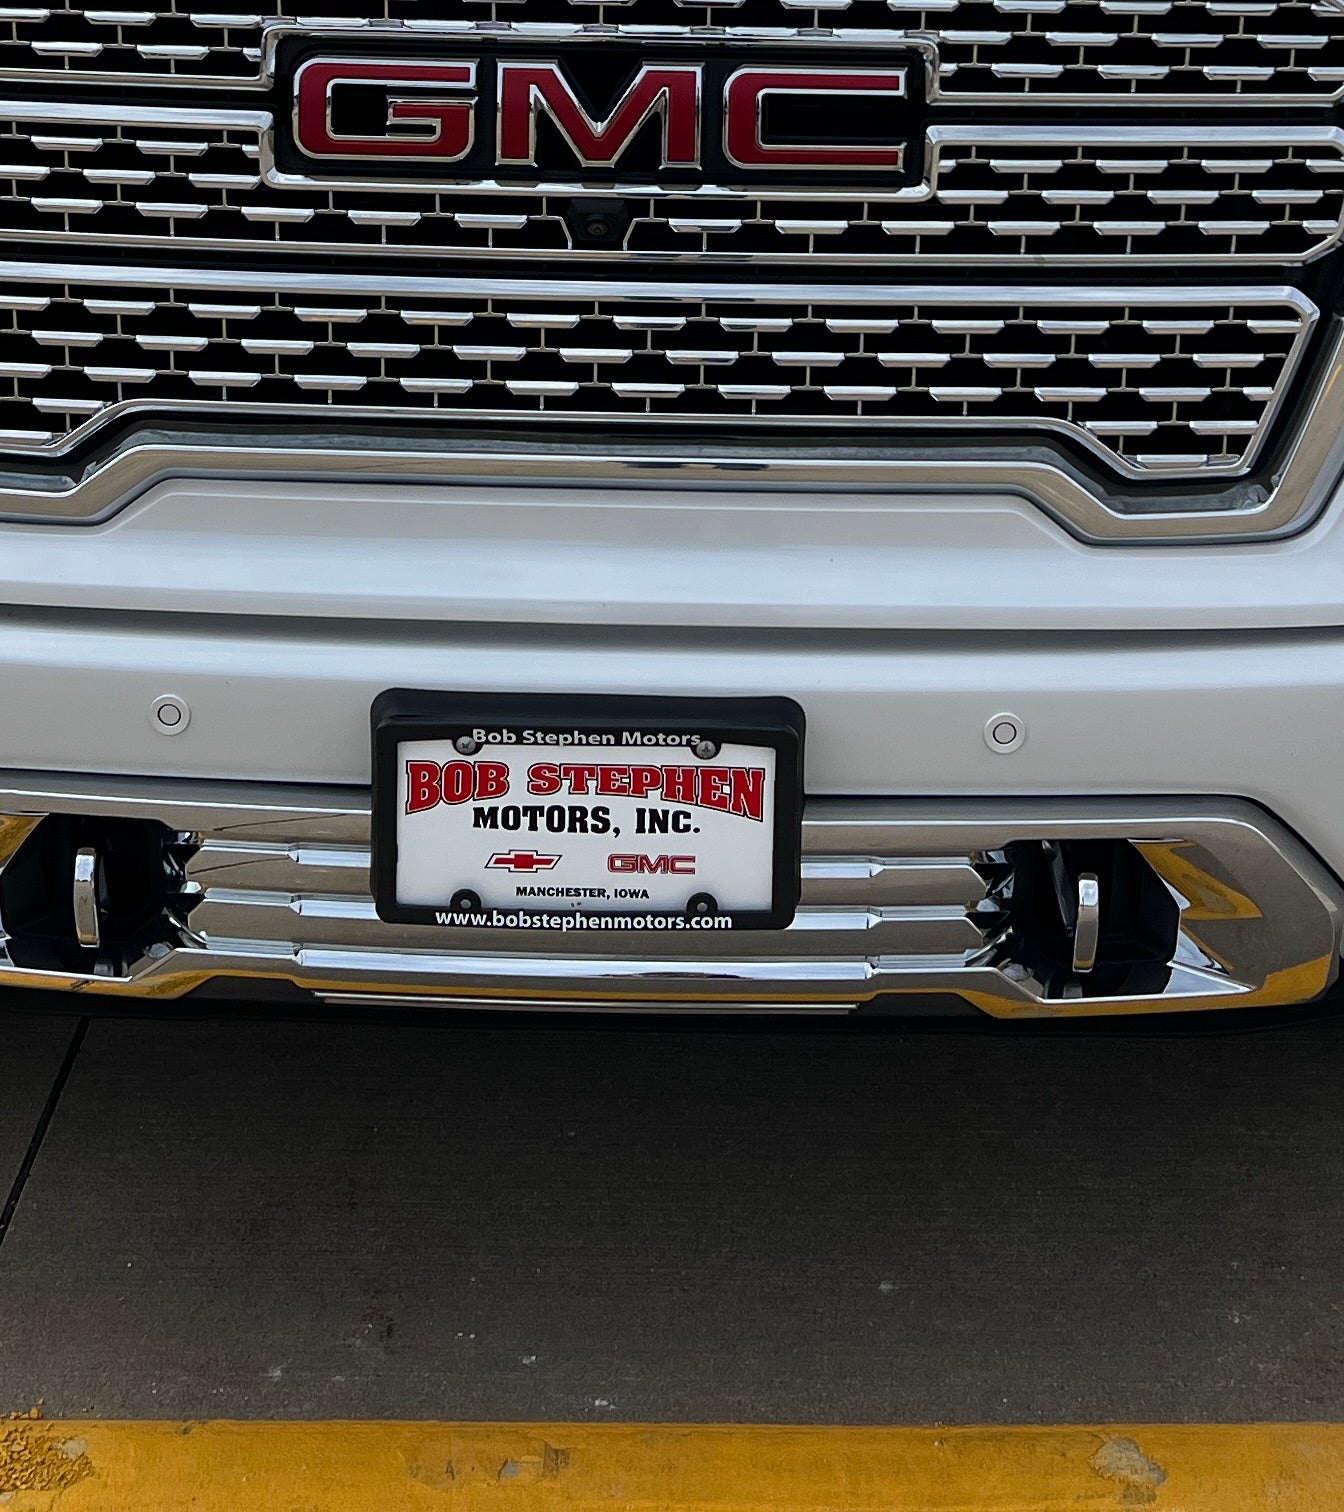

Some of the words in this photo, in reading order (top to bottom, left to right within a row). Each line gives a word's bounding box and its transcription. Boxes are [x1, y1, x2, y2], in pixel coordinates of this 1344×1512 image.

[292, 56, 908, 172] GMC
[472, 728, 517, 744] Bob
[522, 730, 615, 747] Stephen
[621, 731, 701, 746] Motors
[405, 759, 510, 816] BOB
[527, 762, 765, 823] STEPHEN
[472, 805, 621, 838] MOTORS,
[635, 807, 701, 835] INC.
[607, 853, 696, 875] GMC
[515, 886, 610, 900] MANCHESTER,
[613, 888, 649, 899] IOWA
[435, 910, 733, 933] www.bobstephenmotors.com
